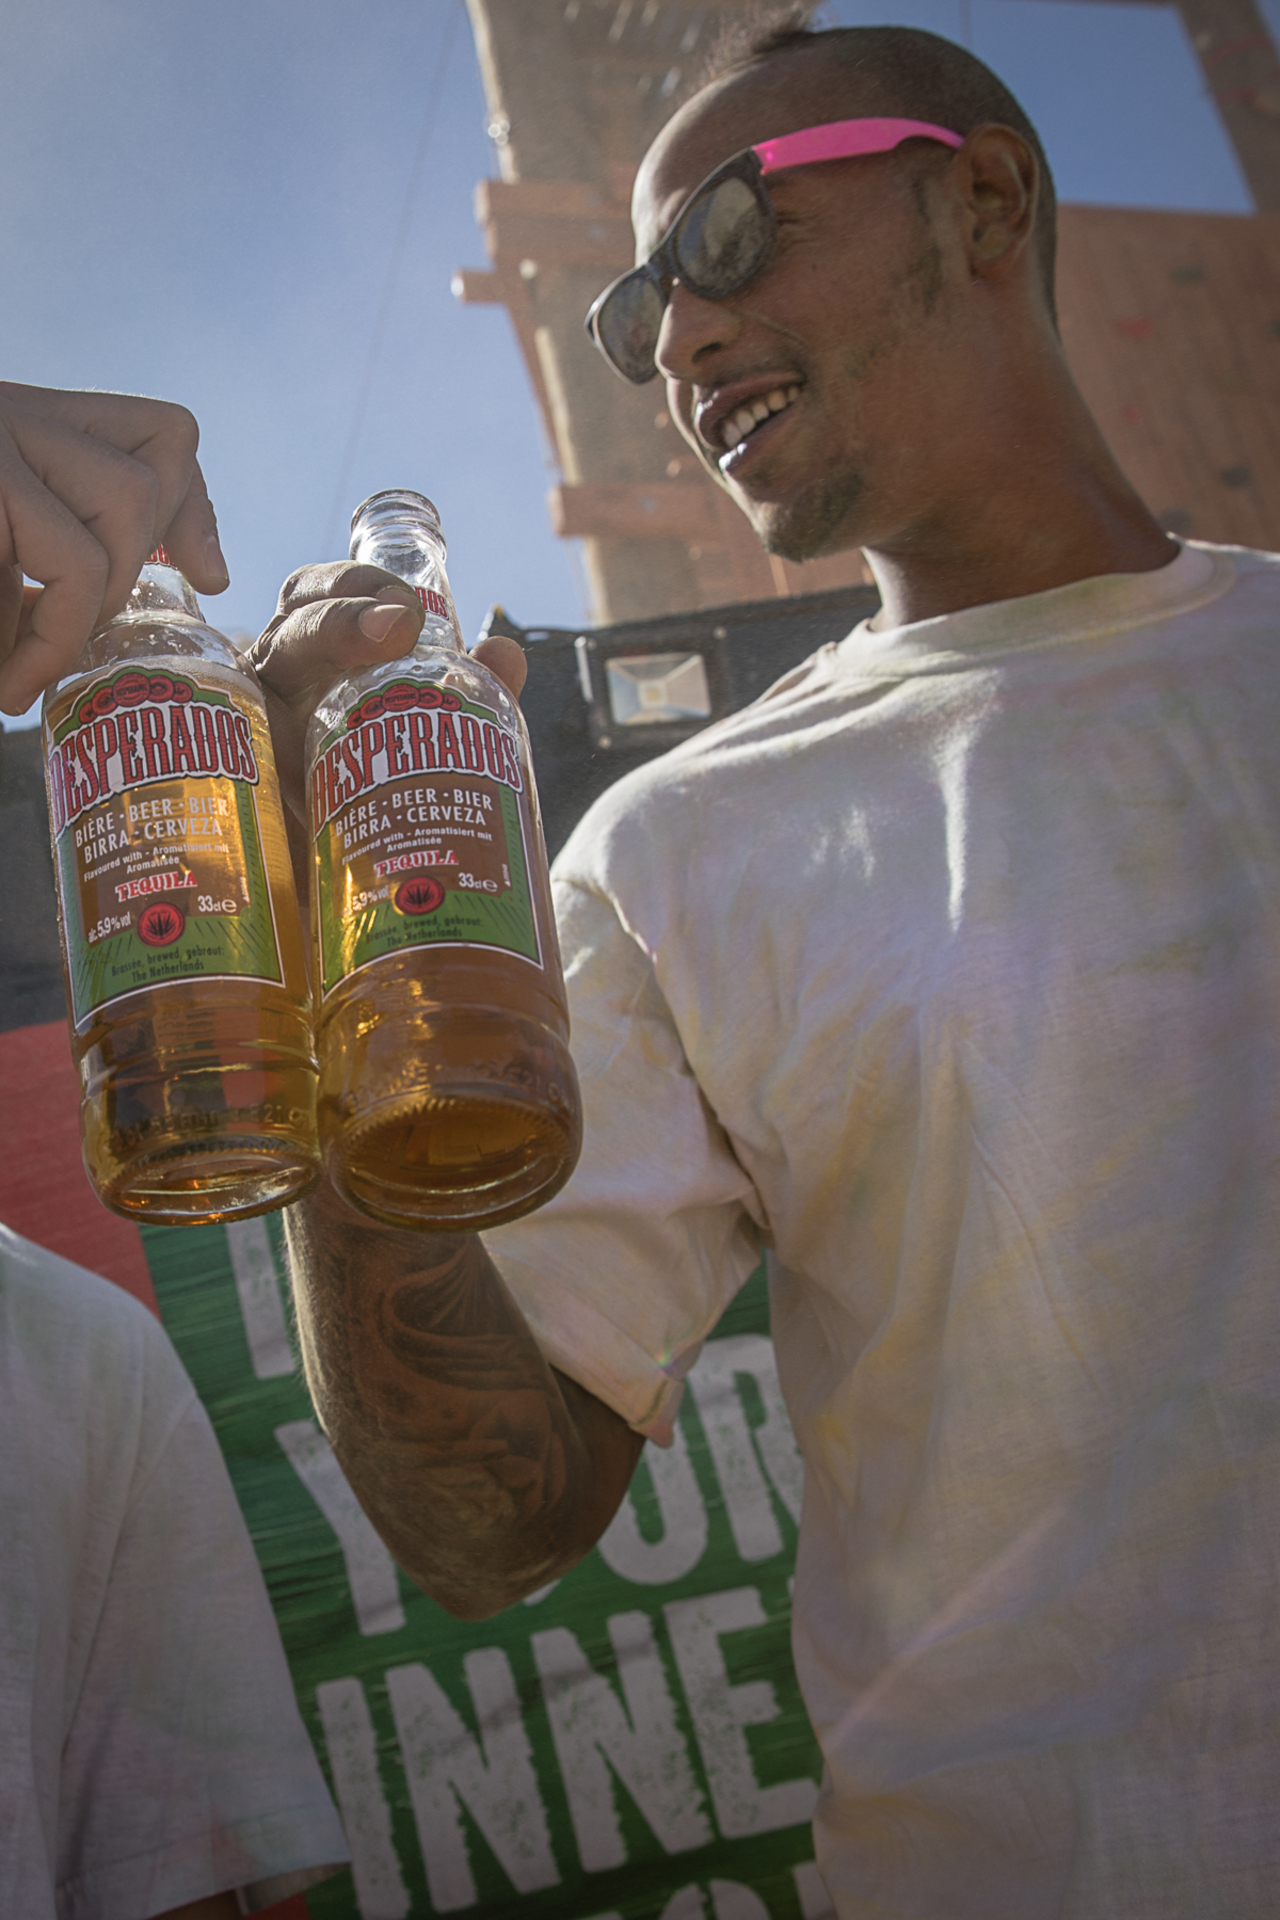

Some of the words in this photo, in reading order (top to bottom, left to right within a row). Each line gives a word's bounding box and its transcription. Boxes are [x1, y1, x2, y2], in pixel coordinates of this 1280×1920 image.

[50, 704, 257, 837] DESPERADOS
[311, 711, 521, 838] DESPERADOS
[75, 812, 115, 848] BIÈRE
[128, 798, 174, 823] BEER
[188, 797, 229, 816] BIER
[335, 800, 378, 838] BIÈRE
[391, 788, 438, 809] BEER
[453, 788, 493, 811] BIER
[343, 814, 392, 849] BIRRA
[406, 805, 486, 826] CERVEZA
[83, 857, 121, 882] Flavoured
[122, 851, 143, 864] with
[153, 843, 212, 856] Aromatisiert
[84, 829, 130, 864] BIRRA
[144, 817, 223, 840] CERVEZA
[341, 838, 382, 866] Flavoured
[383, 832, 404, 844] with
[414, 826, 475, 837] Aromatisiert
[477, 831, 493, 842] mit
[386, 836, 442, 854] Aromatisée
[126, 855, 180, 874] Aromatisée
[373, 850, 459, 877] TEQUILA
[115, 870, 198, 902] TEQUILA
[131, 970, 147, 983] The
[149, 959, 205, 978] Netherlands
[273, 1333, 805, 1637] YUR
[316, 1583, 822, 1919] INNE
